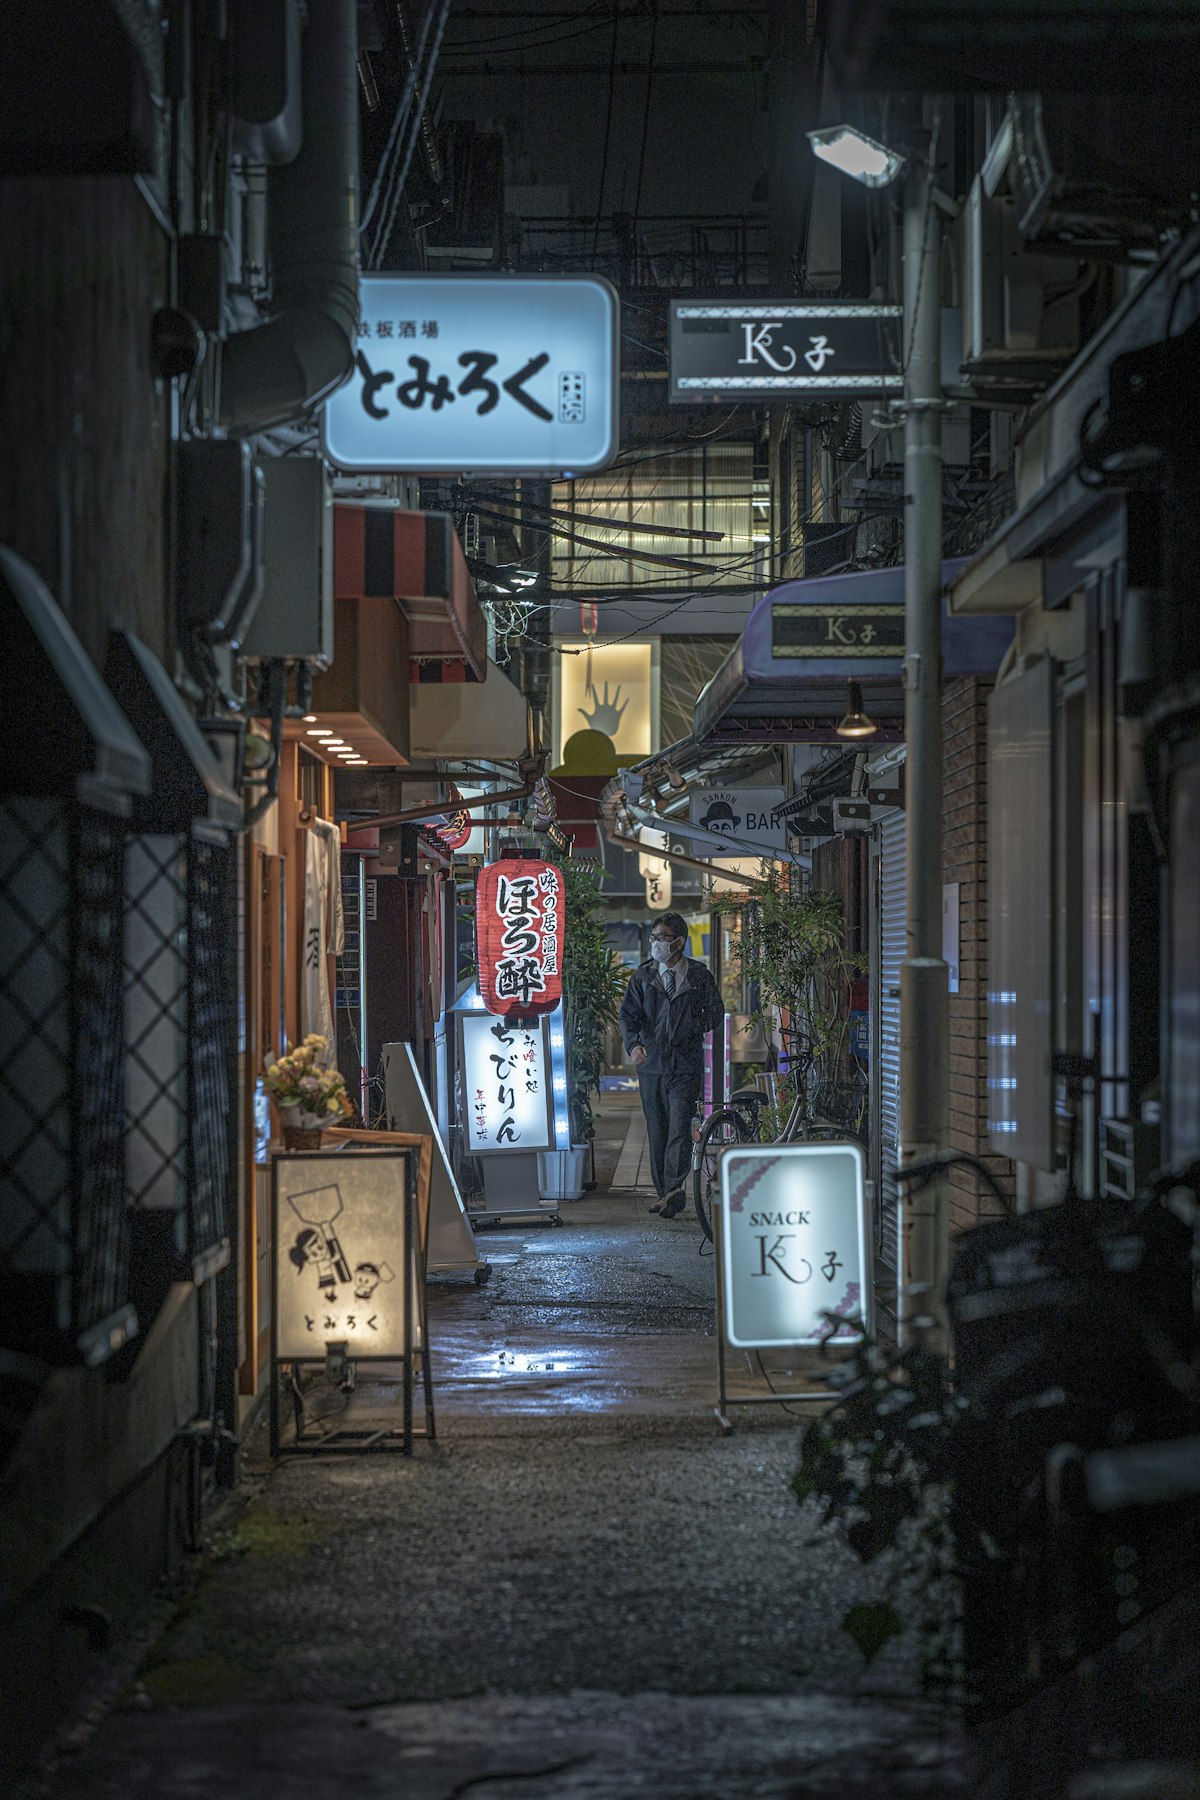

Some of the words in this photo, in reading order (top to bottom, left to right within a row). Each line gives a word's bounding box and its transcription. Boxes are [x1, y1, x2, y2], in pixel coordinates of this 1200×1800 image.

[356, 349, 554, 422] とみろく
[702, 792, 737, 806] SANKON
[746, 813, 781, 830] BAR
[496, 876, 545, 1006] ほろ酔
[539, 868, 559, 975] 味の居酒屋
[489, 1022, 522, 1144] ちびりん
[749, 1211, 811, 1227] SNACK
[304, 1314, 379, 1332] とみろく
